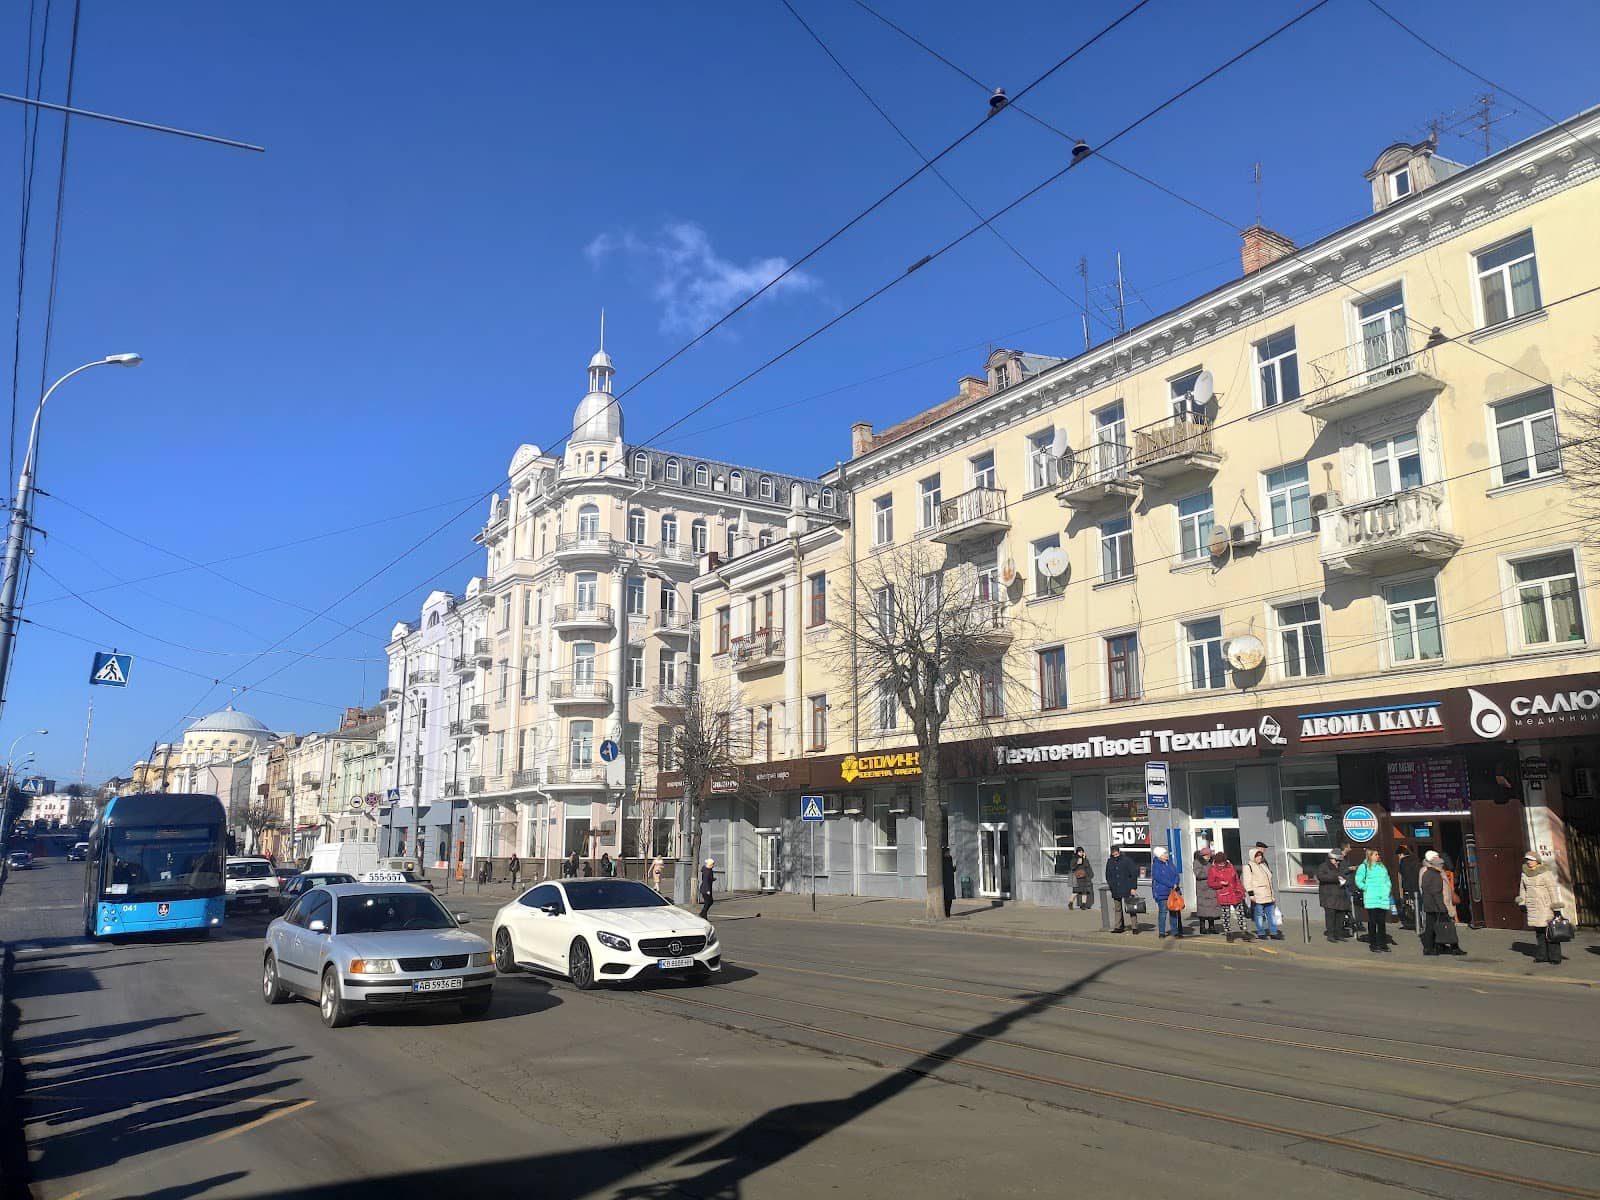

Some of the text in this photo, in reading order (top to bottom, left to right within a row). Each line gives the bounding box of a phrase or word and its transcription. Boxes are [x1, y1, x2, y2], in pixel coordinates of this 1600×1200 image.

[1300, 713, 1374, 737] AROMA
[1379, 707, 1442, 731] KAVA
[1153, 723, 1257, 753] Техніки
[123, 904, 137, 912] 041
